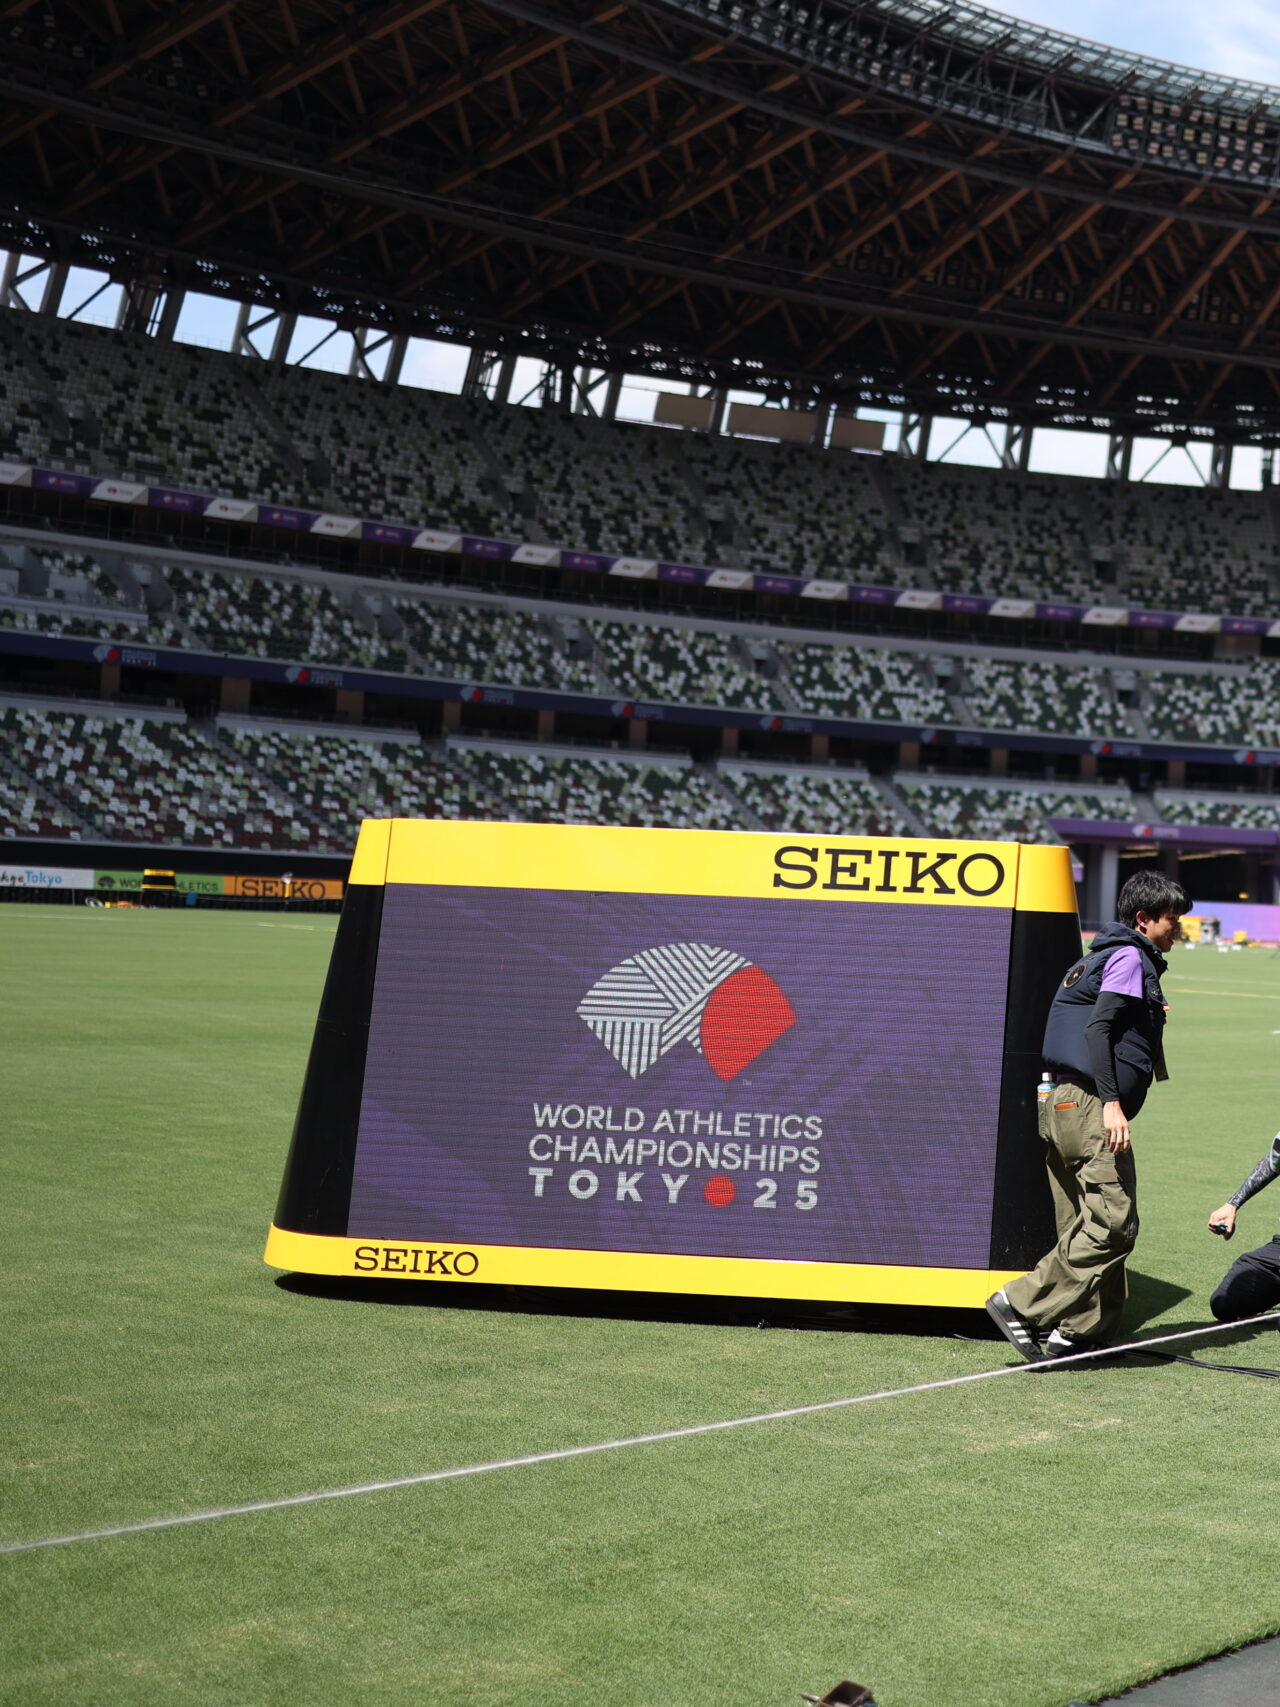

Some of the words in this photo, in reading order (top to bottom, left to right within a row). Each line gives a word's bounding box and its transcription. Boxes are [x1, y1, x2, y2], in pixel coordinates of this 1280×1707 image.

[25, 871, 63, 888] Tokyo
[773, 845, 1005, 897] SEIKO
[532, 1103, 645, 1132] WORLD
[652, 1109, 823, 1140] ATHLETICS
[528, 1134, 821, 1174] CHAMPIONSHIPS
[753, 1178, 819, 1210] 25
[354, 1246, 479, 1276] SEIKO
